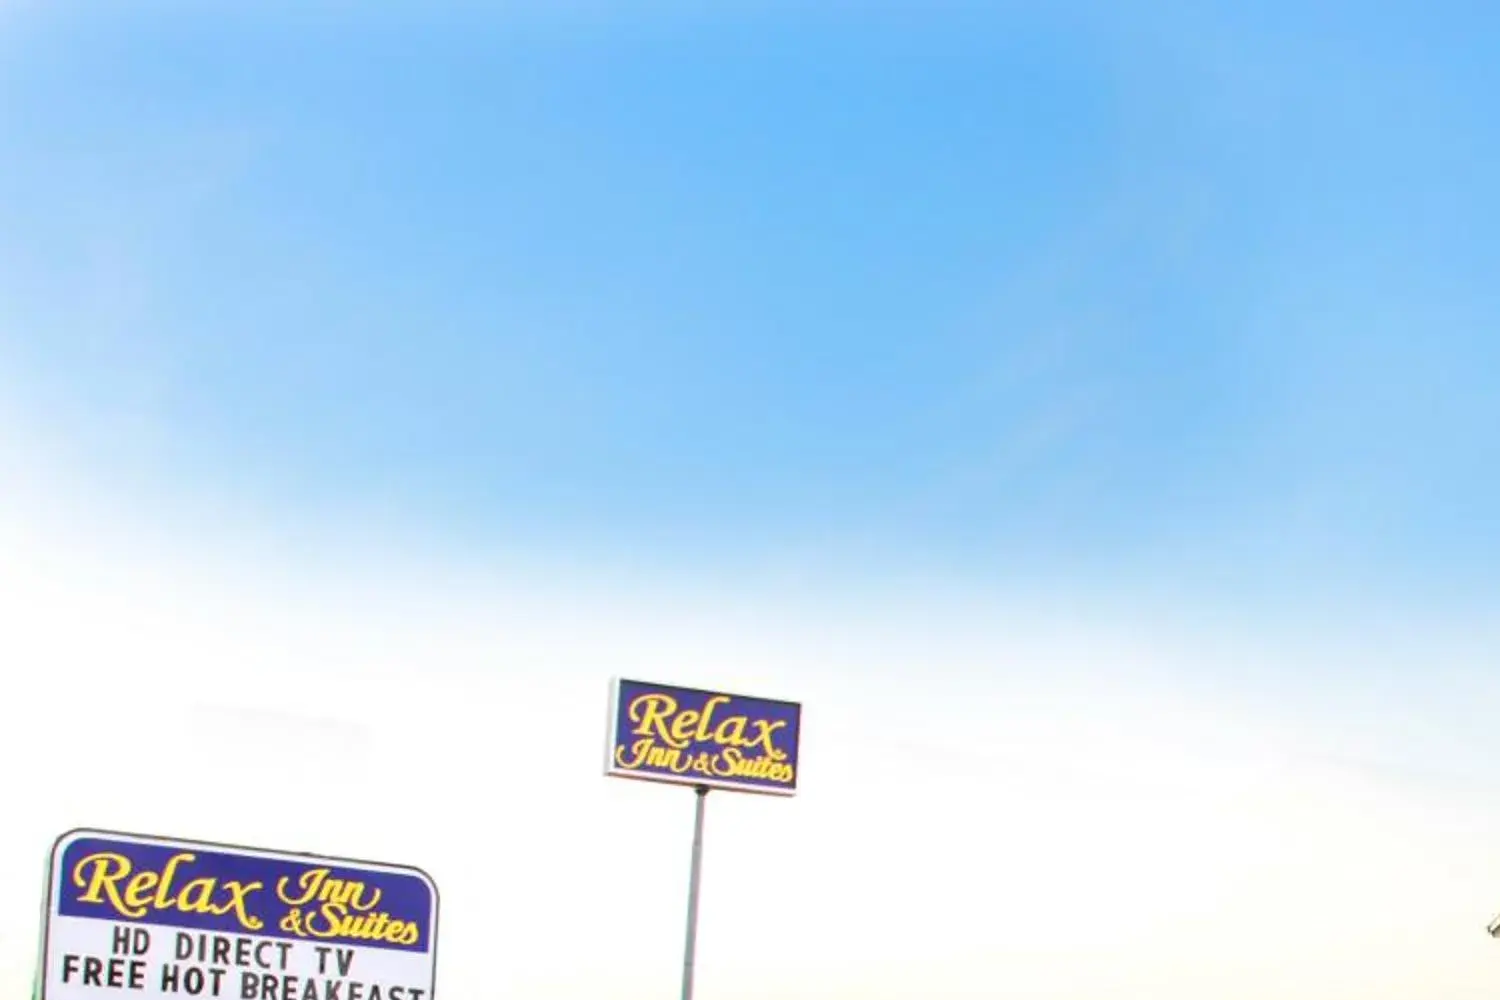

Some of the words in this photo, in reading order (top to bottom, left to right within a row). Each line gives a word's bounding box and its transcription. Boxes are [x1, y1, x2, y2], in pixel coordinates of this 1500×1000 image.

[629, 693, 787, 760] Relax
[615, 739, 692, 773] Inn
[711, 747, 793, 782] Suites
[73, 852, 264, 930] Relax
[277, 868, 382, 911] Inn
[305, 902, 419, 945] Suites
[112, 925, 150, 955] HD
[175, 931, 294, 970] DIRECT
[314, 945, 355, 977] TV
[62, 954, 146, 989] FREE
[161, 963, 226, 996] HOT
